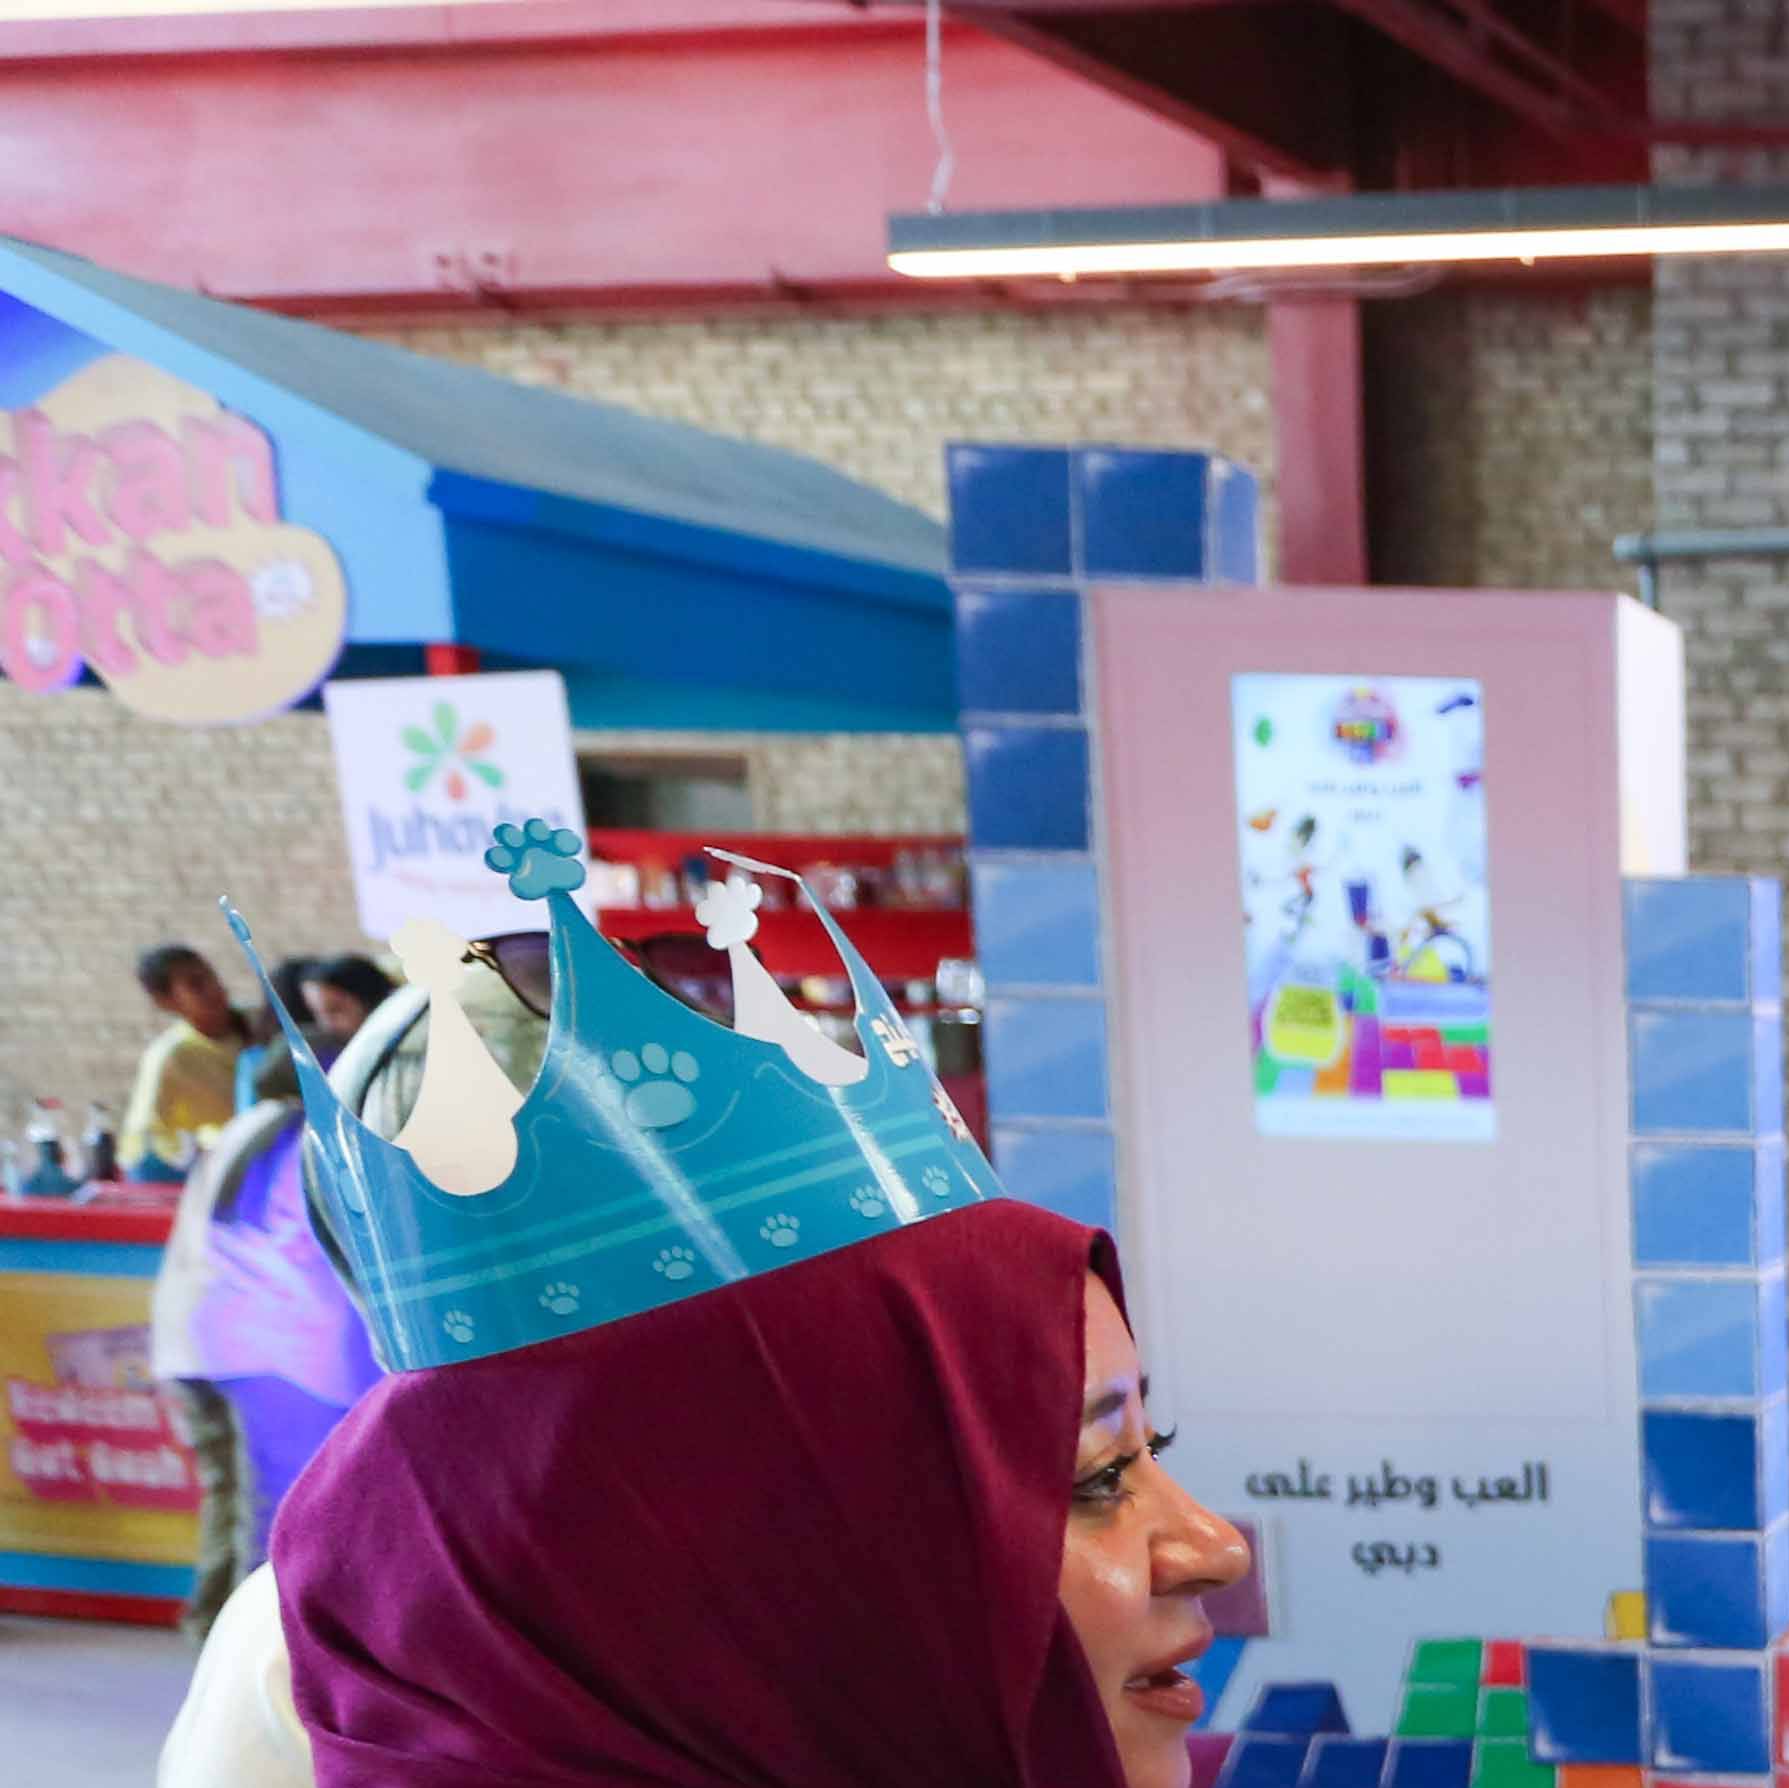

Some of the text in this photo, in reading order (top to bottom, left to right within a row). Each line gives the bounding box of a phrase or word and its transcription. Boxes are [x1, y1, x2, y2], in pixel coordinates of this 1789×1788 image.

[1245, 1455, 1550, 1508] العب وطير على
[1351, 1541, 1442, 1576] دبي
